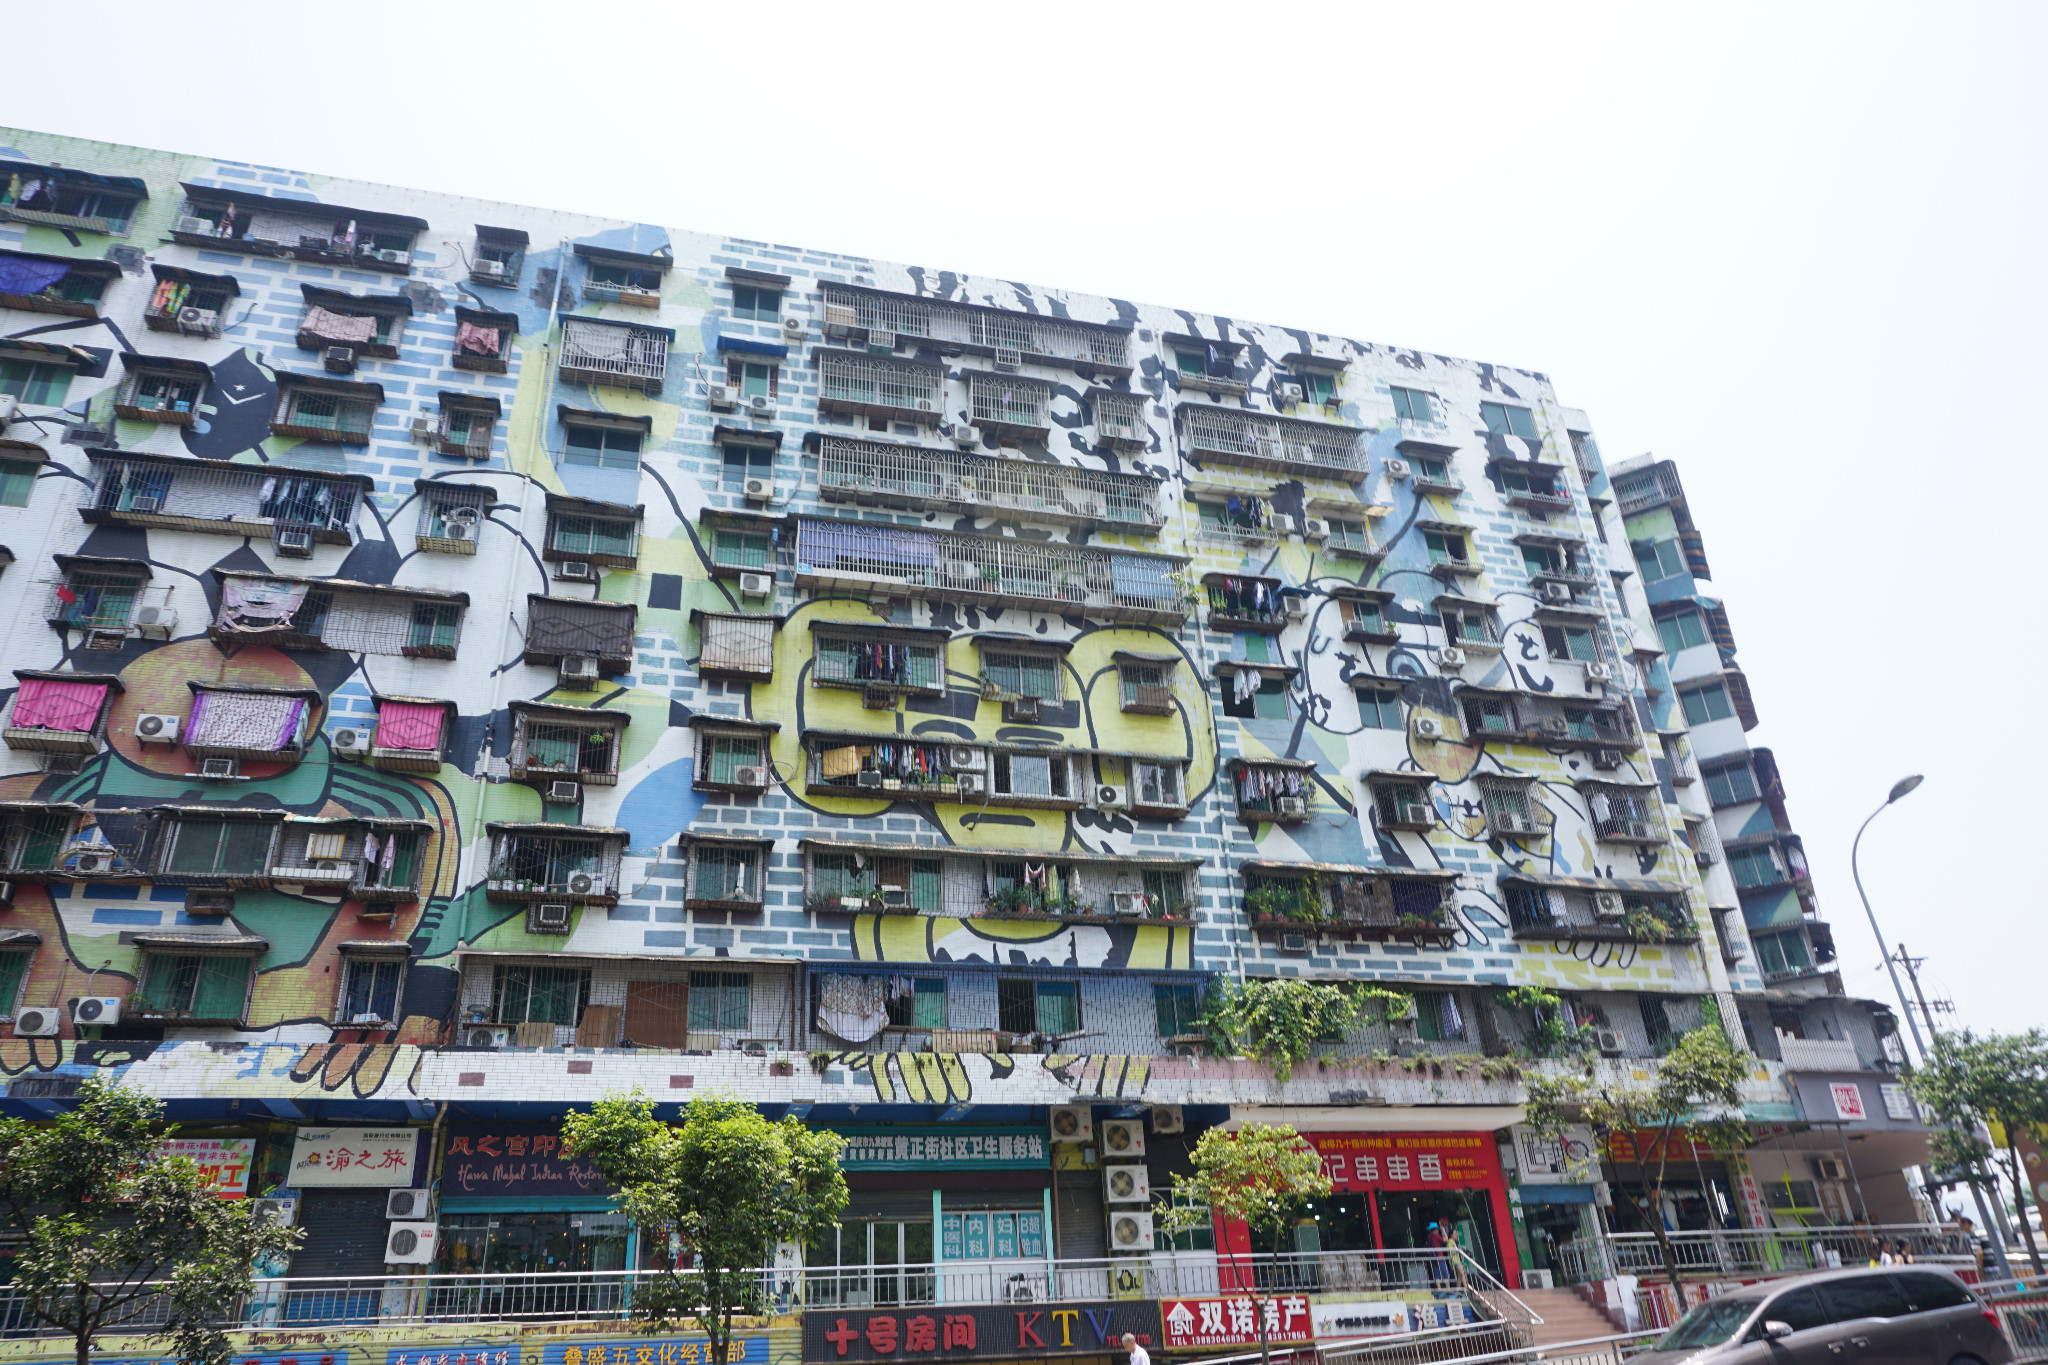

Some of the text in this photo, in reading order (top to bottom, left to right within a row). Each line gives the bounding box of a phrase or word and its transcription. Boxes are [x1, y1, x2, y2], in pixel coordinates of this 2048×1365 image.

[326, 1147, 407, 1173] 渝之旅
[895, 1135, 1043, 1160] 黄正街社区卫生服务站
[458, 1164, 488, 1191] Hawa
[492, 1163, 526, 1187] Mahal
[531, 1163, 562, 1181] Indian
[943, 1217, 961, 1257] 中医科
[968, 1217, 985, 1257] 内科
[998, 1217, 1014, 1257] 妇科
[1020, 1216, 1040, 1234] B超
[826, 1308, 1113, 1356] 十号房间 KTV
[1198, 1295, 1307, 1335] 双诺房产
